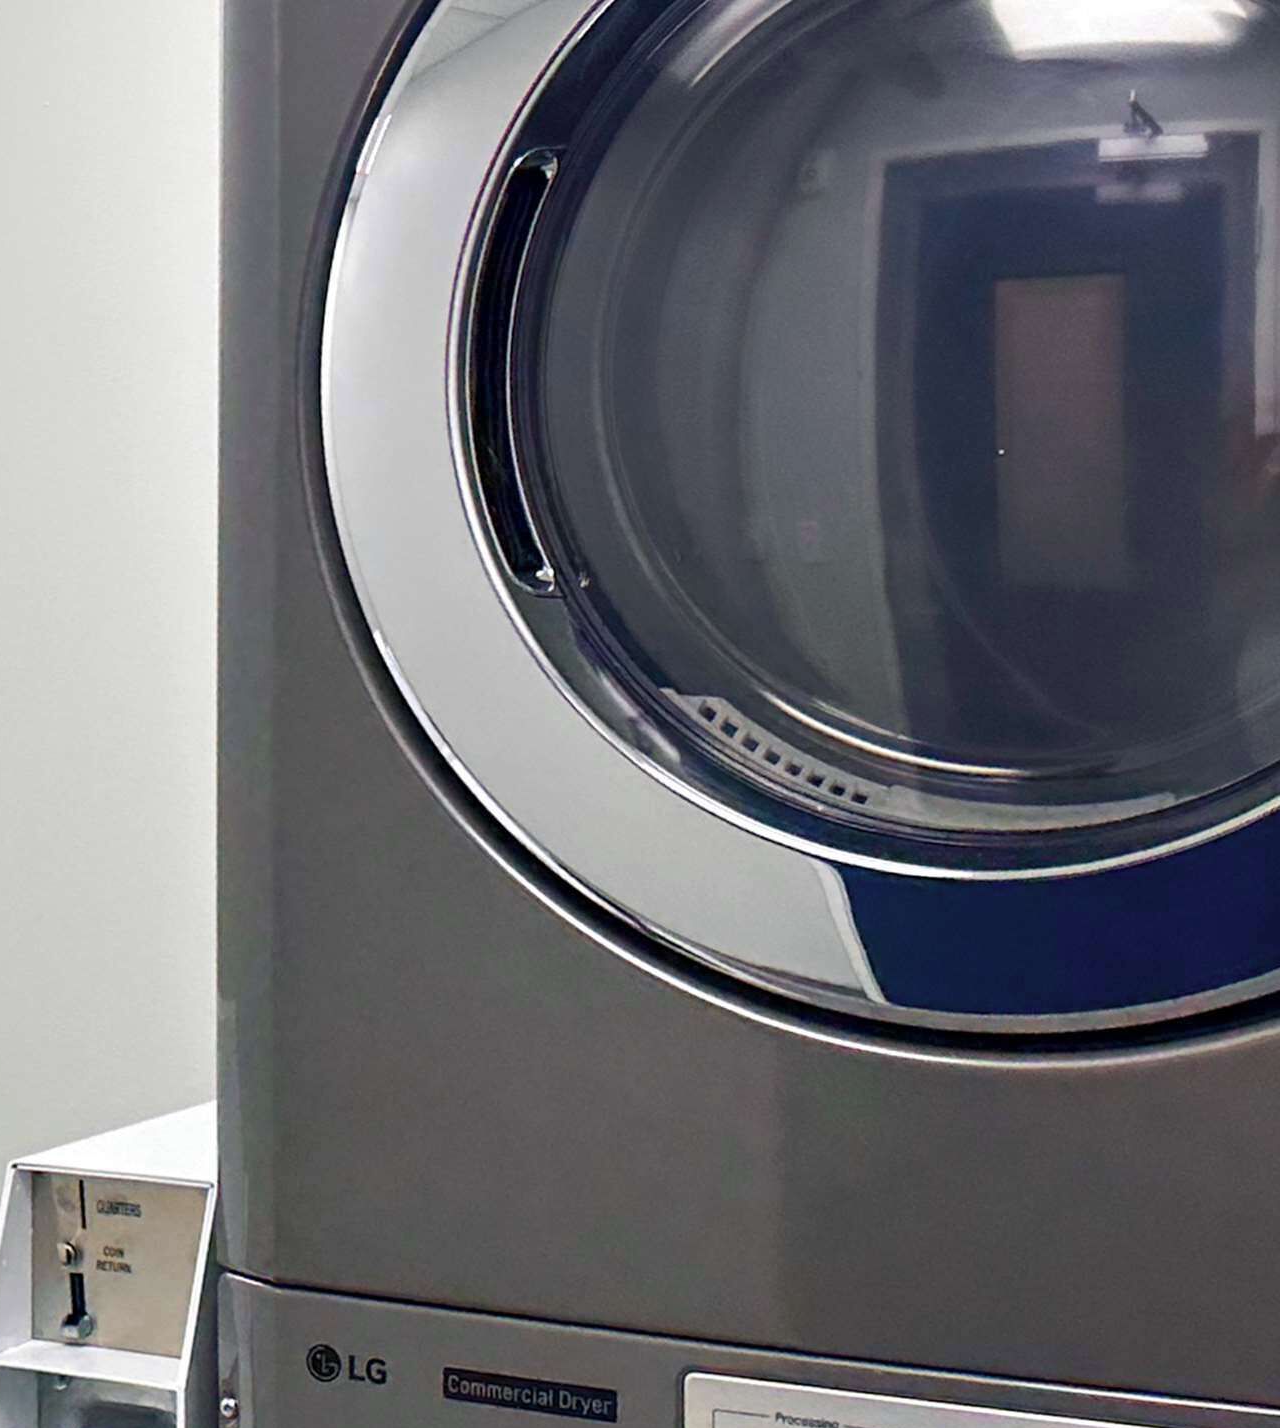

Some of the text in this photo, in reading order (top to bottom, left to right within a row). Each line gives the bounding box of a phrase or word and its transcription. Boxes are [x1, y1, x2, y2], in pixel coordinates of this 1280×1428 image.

[348, 1354, 387, 1384] LG
[447, 1374, 612, 1415] Commercial Dryer
